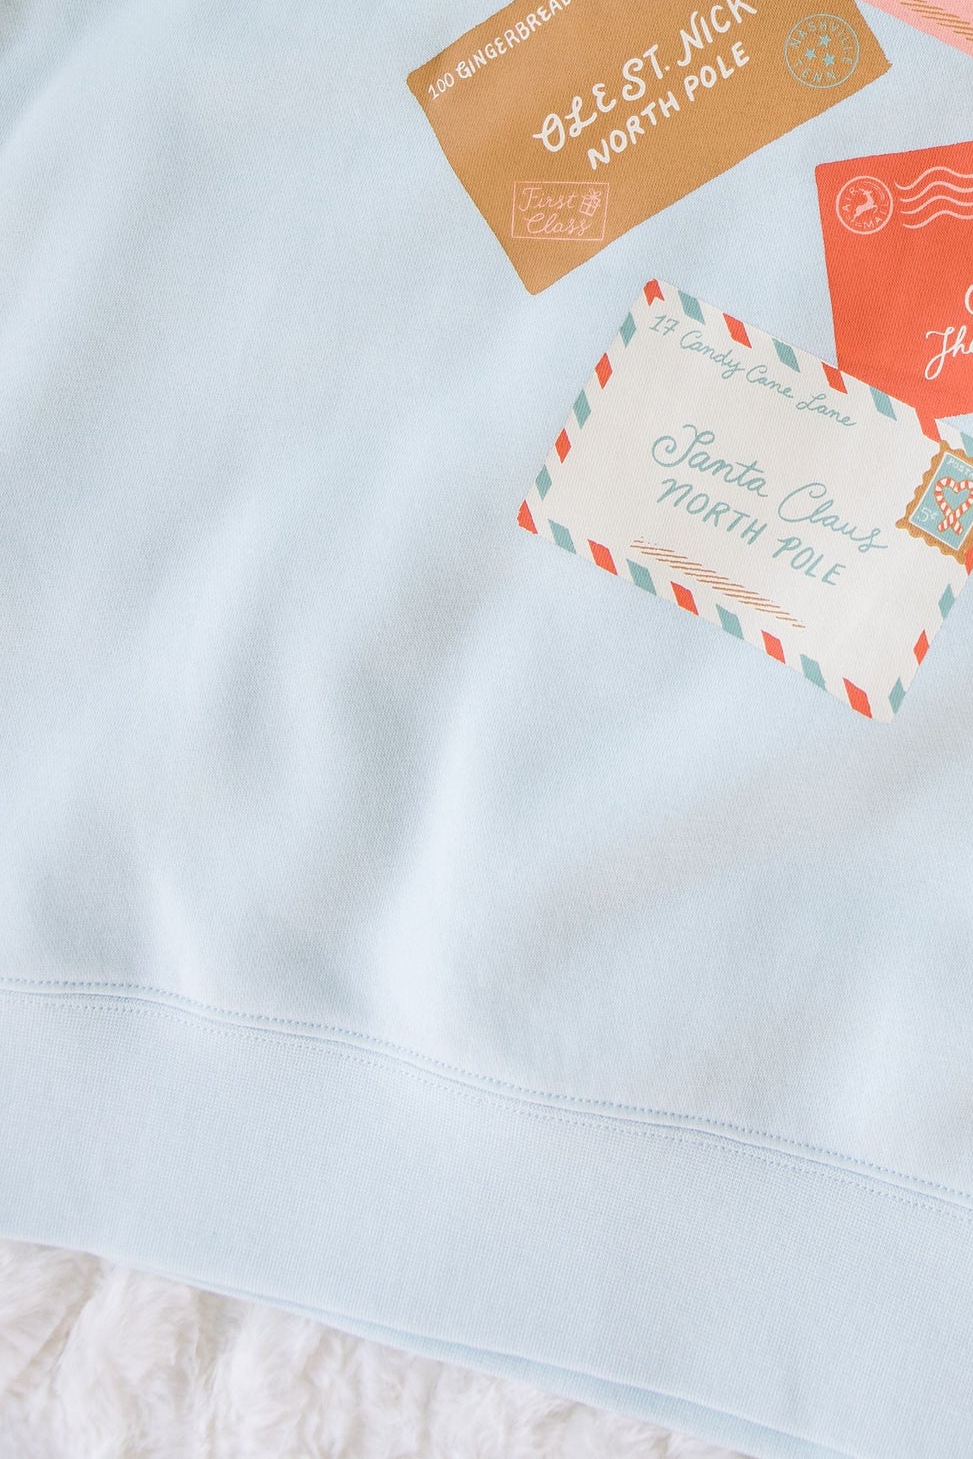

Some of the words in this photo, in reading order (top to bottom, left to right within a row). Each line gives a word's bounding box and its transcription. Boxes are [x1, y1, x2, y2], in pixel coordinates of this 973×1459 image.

[428, 72, 455, 100] 100
[533, 83, 617, 153] OLE
[621, 46, 671, 103] ST.
[587, 93, 680, 170] NORTH
[685, 41, 750, 101] POLE
[518, 187, 578, 212] First
[525, 211, 592, 237] Class
[649, 314, 680, 336] 17
[680, 330, 745, 379] Candy
[745, 364, 795, 399] Cane
[797, 393, 856, 427] Lane
[651, 424, 768, 498] Santa
[778, 482, 888, 554] Claus
[658, 478, 769, 545] NORTH
[772, 533, 846, 587] POLE
